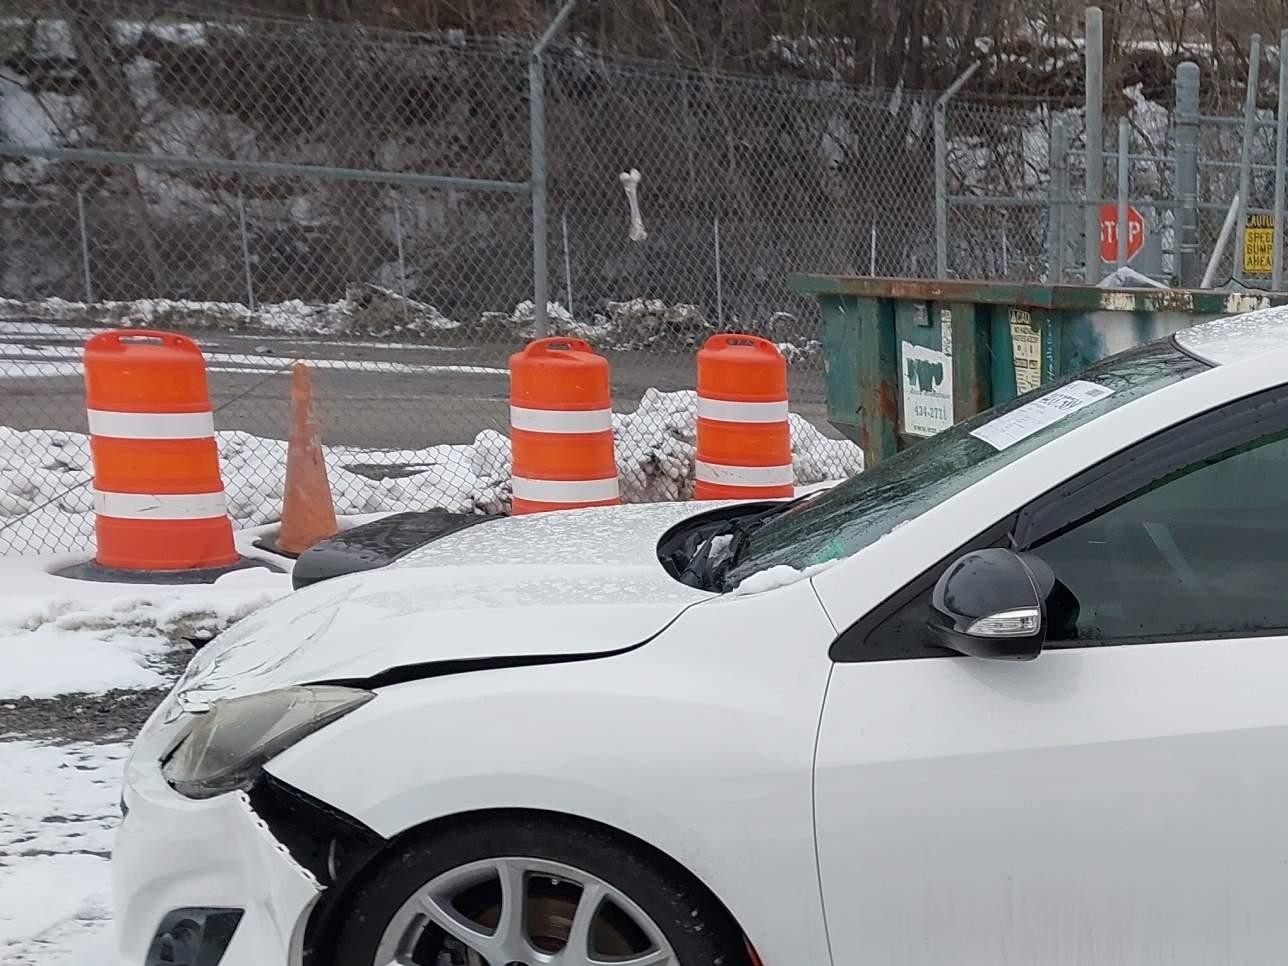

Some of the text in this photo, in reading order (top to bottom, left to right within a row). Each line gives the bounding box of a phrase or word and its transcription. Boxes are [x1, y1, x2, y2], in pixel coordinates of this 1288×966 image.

[1247, 231, 1274, 243] SPEE
[1246, 243, 1273, 255] BUMP
[1246, 255, 1273, 267] AHEA
